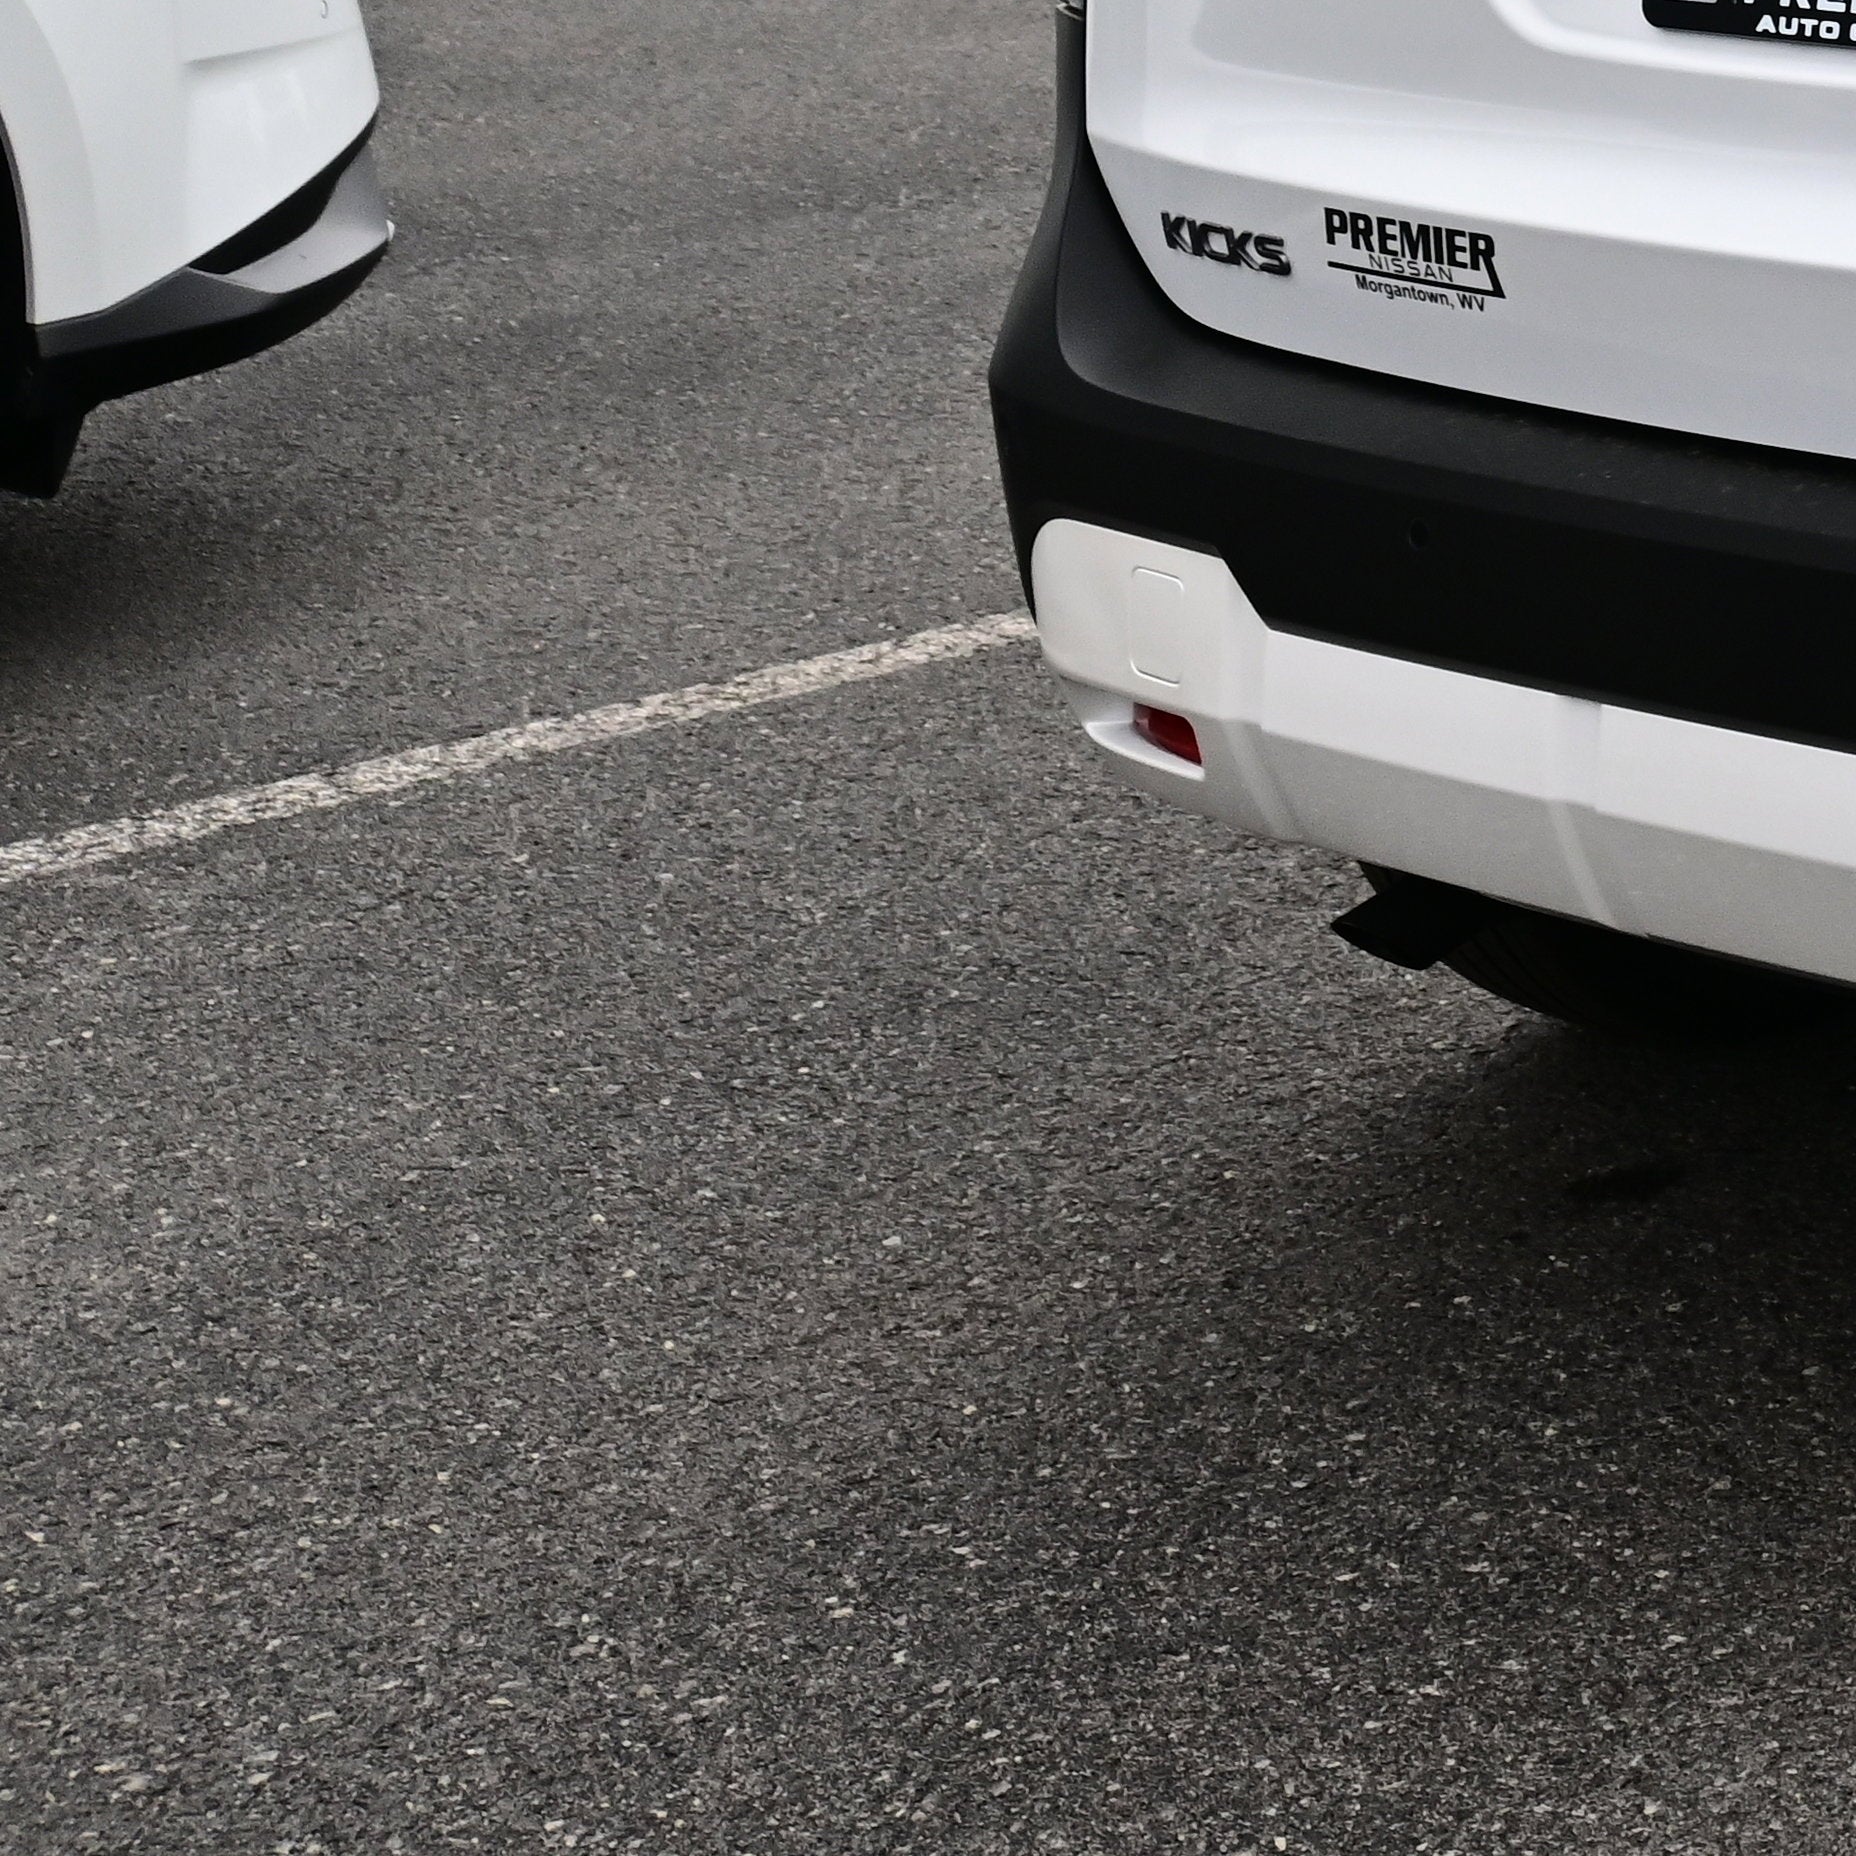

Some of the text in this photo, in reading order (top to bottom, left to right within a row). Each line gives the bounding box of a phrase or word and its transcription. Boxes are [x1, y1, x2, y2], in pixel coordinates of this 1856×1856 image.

[1755, 14, 1840, 41] AUTO
[1160, 211, 1292, 276] KICKS
[1323, 206, 1496, 272] PREMIER
[1369, 253, 1454, 283] NISSAN
[1355, 274, 1486, 312] Morgantown, WV
